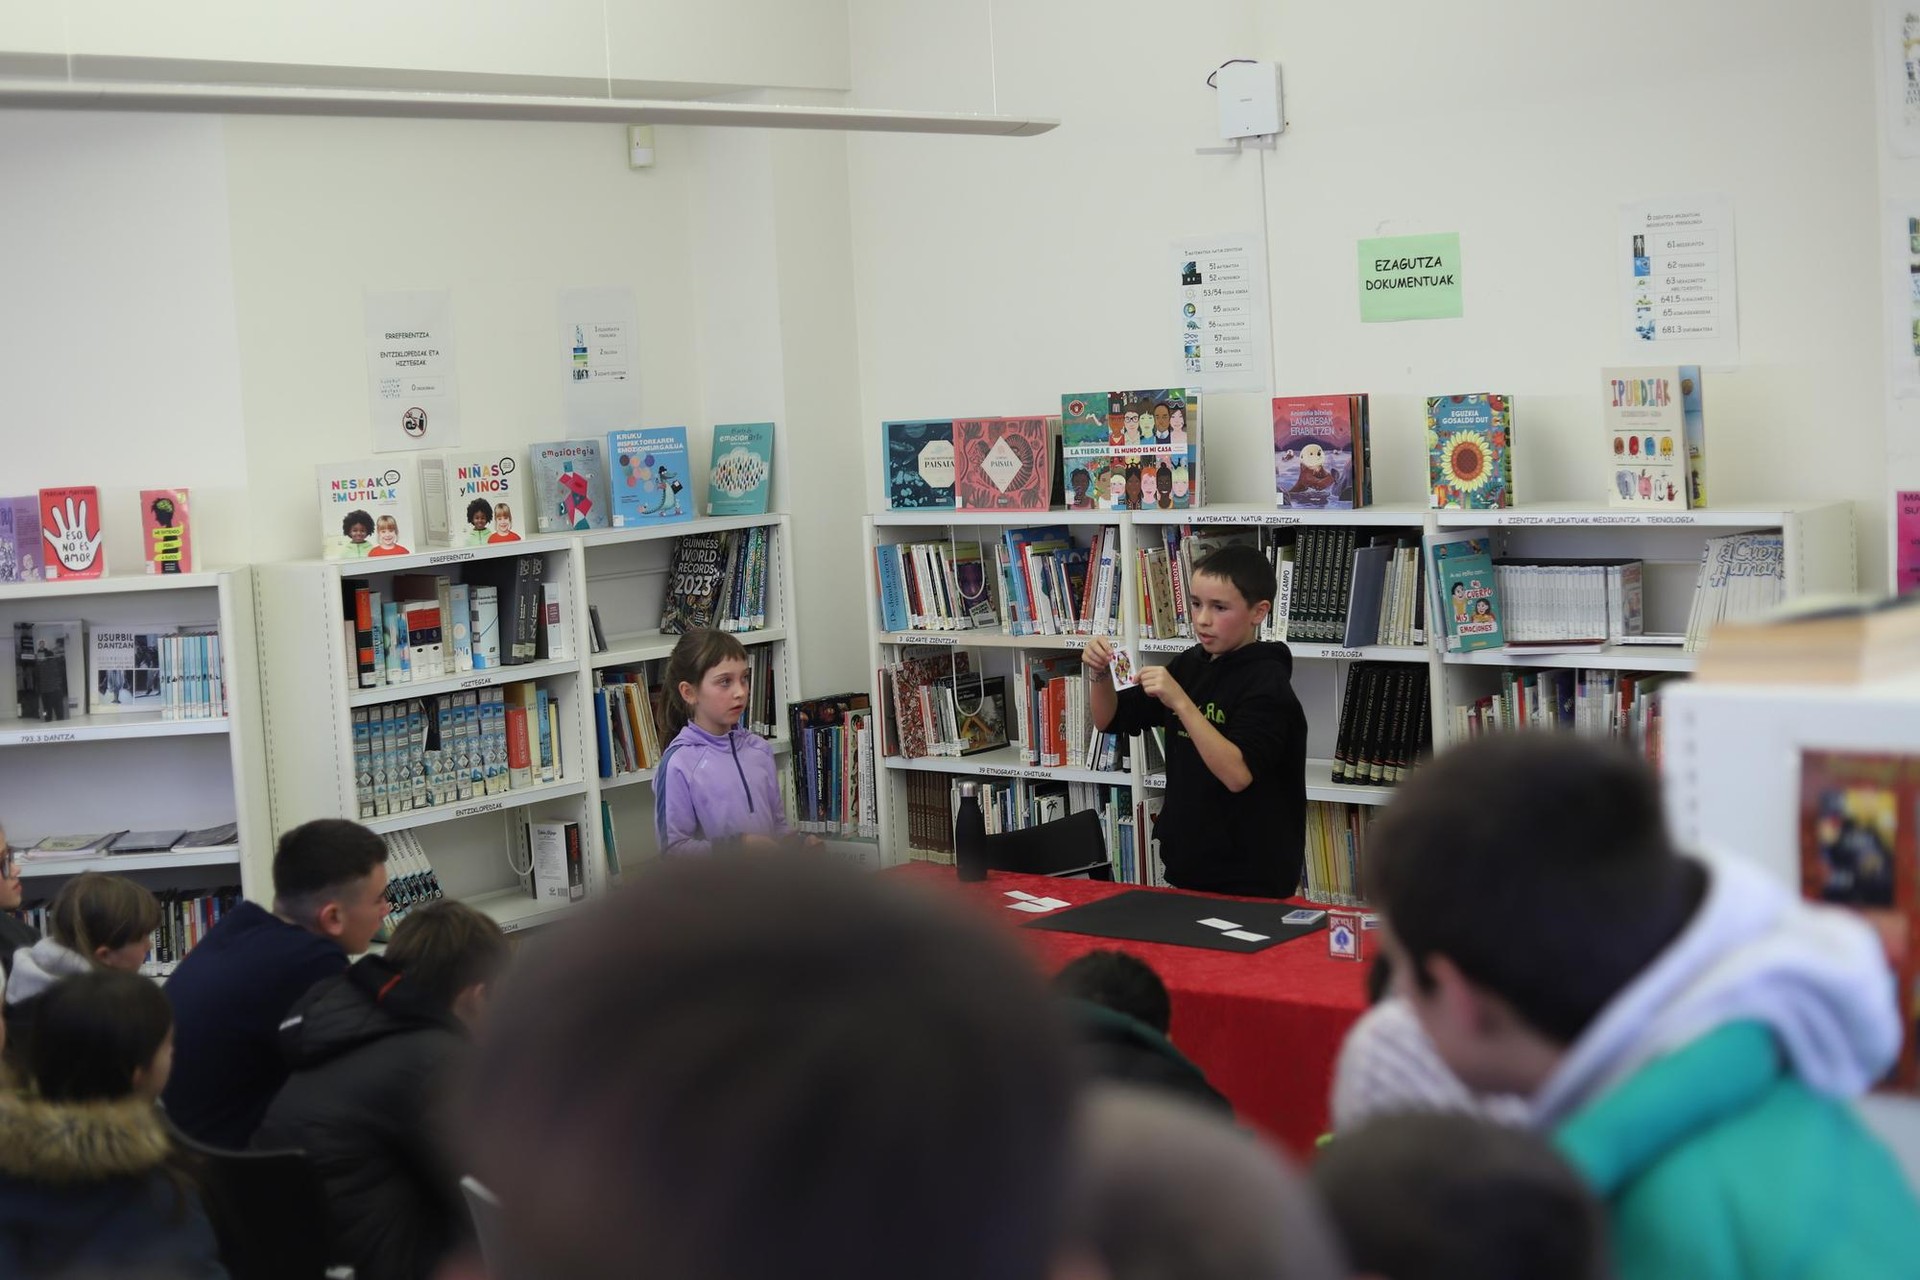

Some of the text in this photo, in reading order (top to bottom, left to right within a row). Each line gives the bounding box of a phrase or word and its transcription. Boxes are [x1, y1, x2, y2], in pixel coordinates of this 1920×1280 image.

[1667, 240, 1675, 248] 61
[1375, 256, 1443, 272] EZAGUTZA
[1667, 261, 1678, 269] 62
[1365, 275, 1454, 291] DOKUMENTUAK
[1661, 295, 1680, 303] 641.5
[1663, 308, 1672, 316] 65
[1662, 325, 1682, 333] 681.3
[380, 350, 427, 358] ENTZIKLOPEDIAK
[1291, 417, 1333, 426] LANABESAK
[1291, 427, 1335, 436] ERABILTZEN
[458, 463, 499, 479] NIÑAS
[332, 477, 383, 490] NESKAK
[460, 478, 508, 496] y NIÑOS
[337, 489, 396, 502] MUTILAK
[1593, 516, 1640, 524] MEDIKUNTZA
[1647, 516, 1695, 524] TEKNOLOGIA
[66, 531, 83, 540] ESO
[62, 542, 89, 552] NO ES
[683, 538, 719, 549] GUINNESS
[64, 553, 91, 563] AMOR
[430, 553, 474, 564] ERREFERENTZIA
[681, 549, 717, 563] WORLD
[678, 562, 715, 574] RECORDS
[674, 575, 712, 596] 2023
[1281, 593, 1289, 601] DE
[1466, 588, 1493, 599] CUERPO
[1455, 613, 1468, 621] MIS
[1459, 625, 1493, 633] EMOCIONES
[97, 634, 134, 642] USURBIL
[97, 642, 134, 650] DANTZAN
[1331, 650, 1363, 658] BIOLOGIA
[460, 678, 492, 688] HIZTEGIAK
[44, 734, 75, 742] DANTZA
[455, 803, 503, 817] ENTZIKLOPEDIAK
[420, 893, 426, 902] 6
[427, 891, 433, 899] 7
[435, 890, 441, 898] 8
[402, 896, 408, 904] 4
[412, 895, 418, 903] 5
[394, 903, 400, 911] 3
